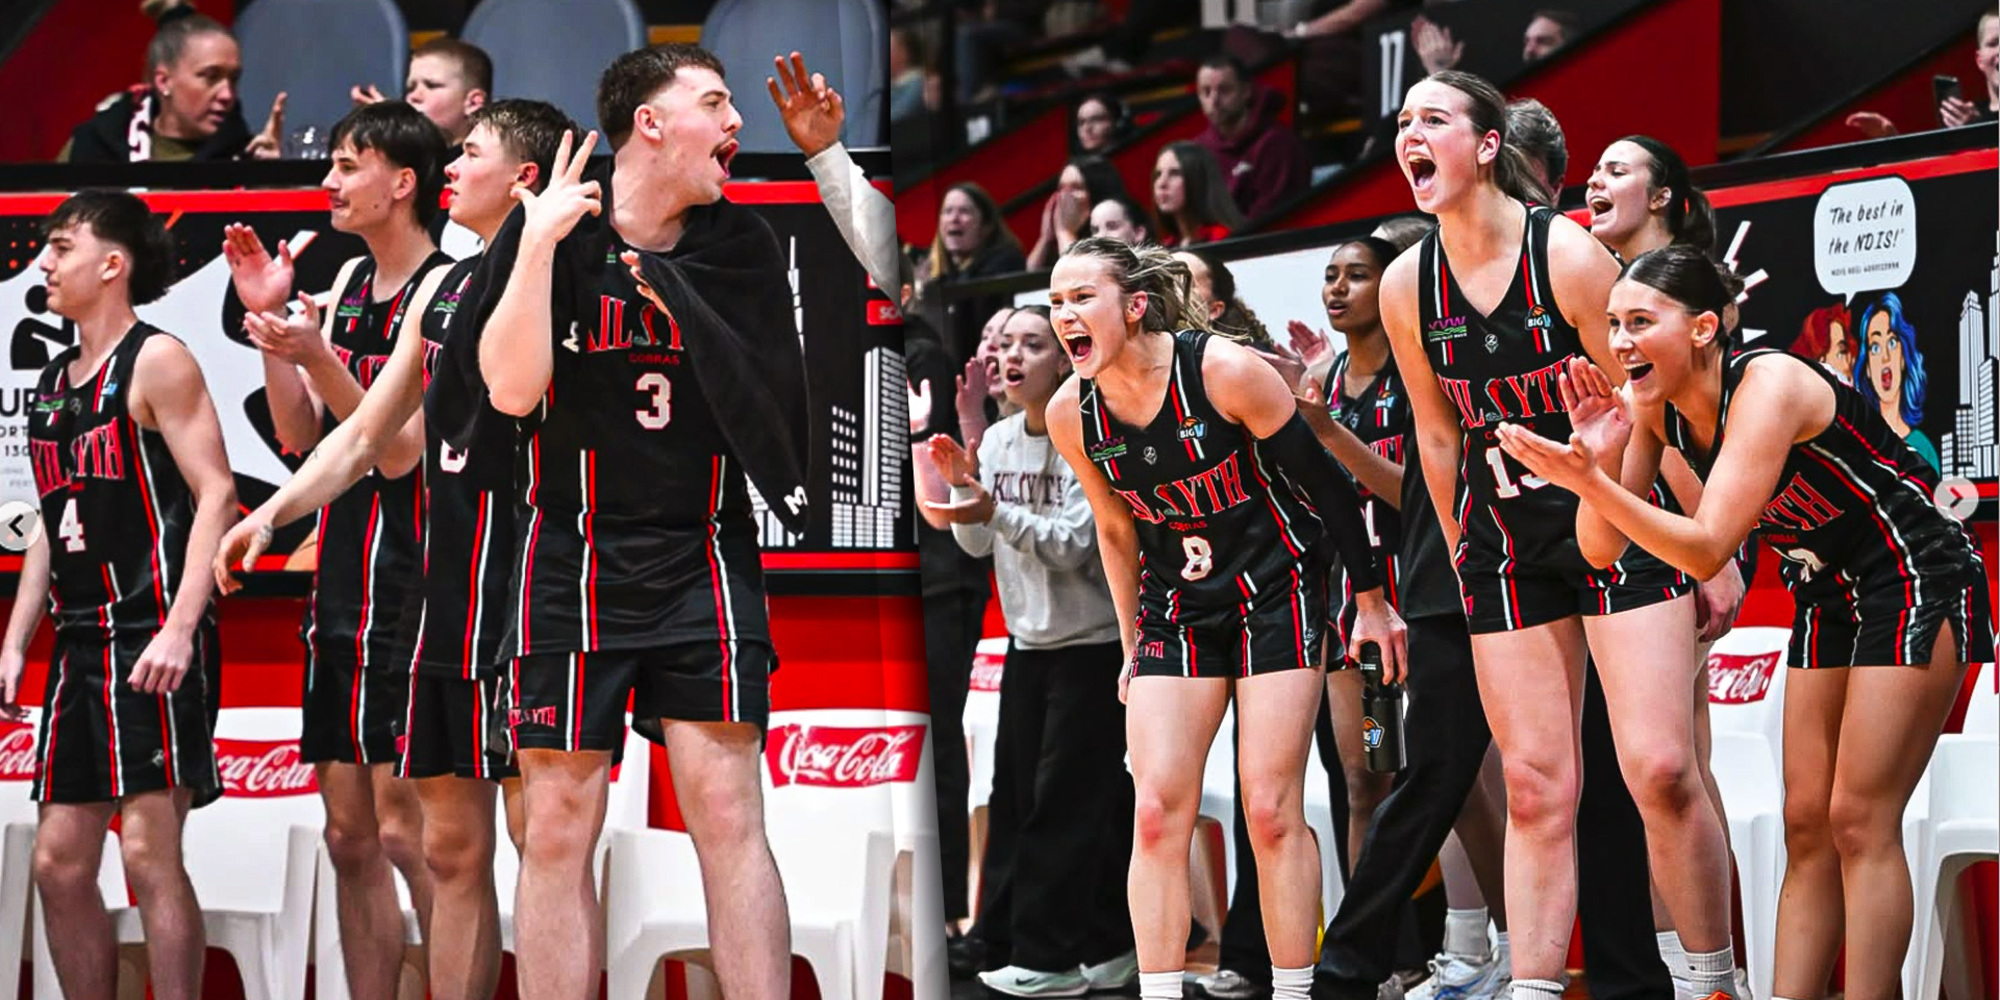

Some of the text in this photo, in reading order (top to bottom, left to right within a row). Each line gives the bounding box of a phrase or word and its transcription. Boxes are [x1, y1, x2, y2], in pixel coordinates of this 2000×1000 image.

[1379, 30, 1405, 117] 17
[1857, 201, 1886, 222] best
[1890, 199, 1904, 217] in
[1828, 237, 1849, 255] the
[629, 354, 681, 366] COBRAS
[635, 372, 671, 430] 3
[1179, 429, 1195, 439] BIG
[58, 498, 86, 552] 4
[1180, 535, 1213, 581] 8
[778, 731, 916, 783] Coca-Cola
